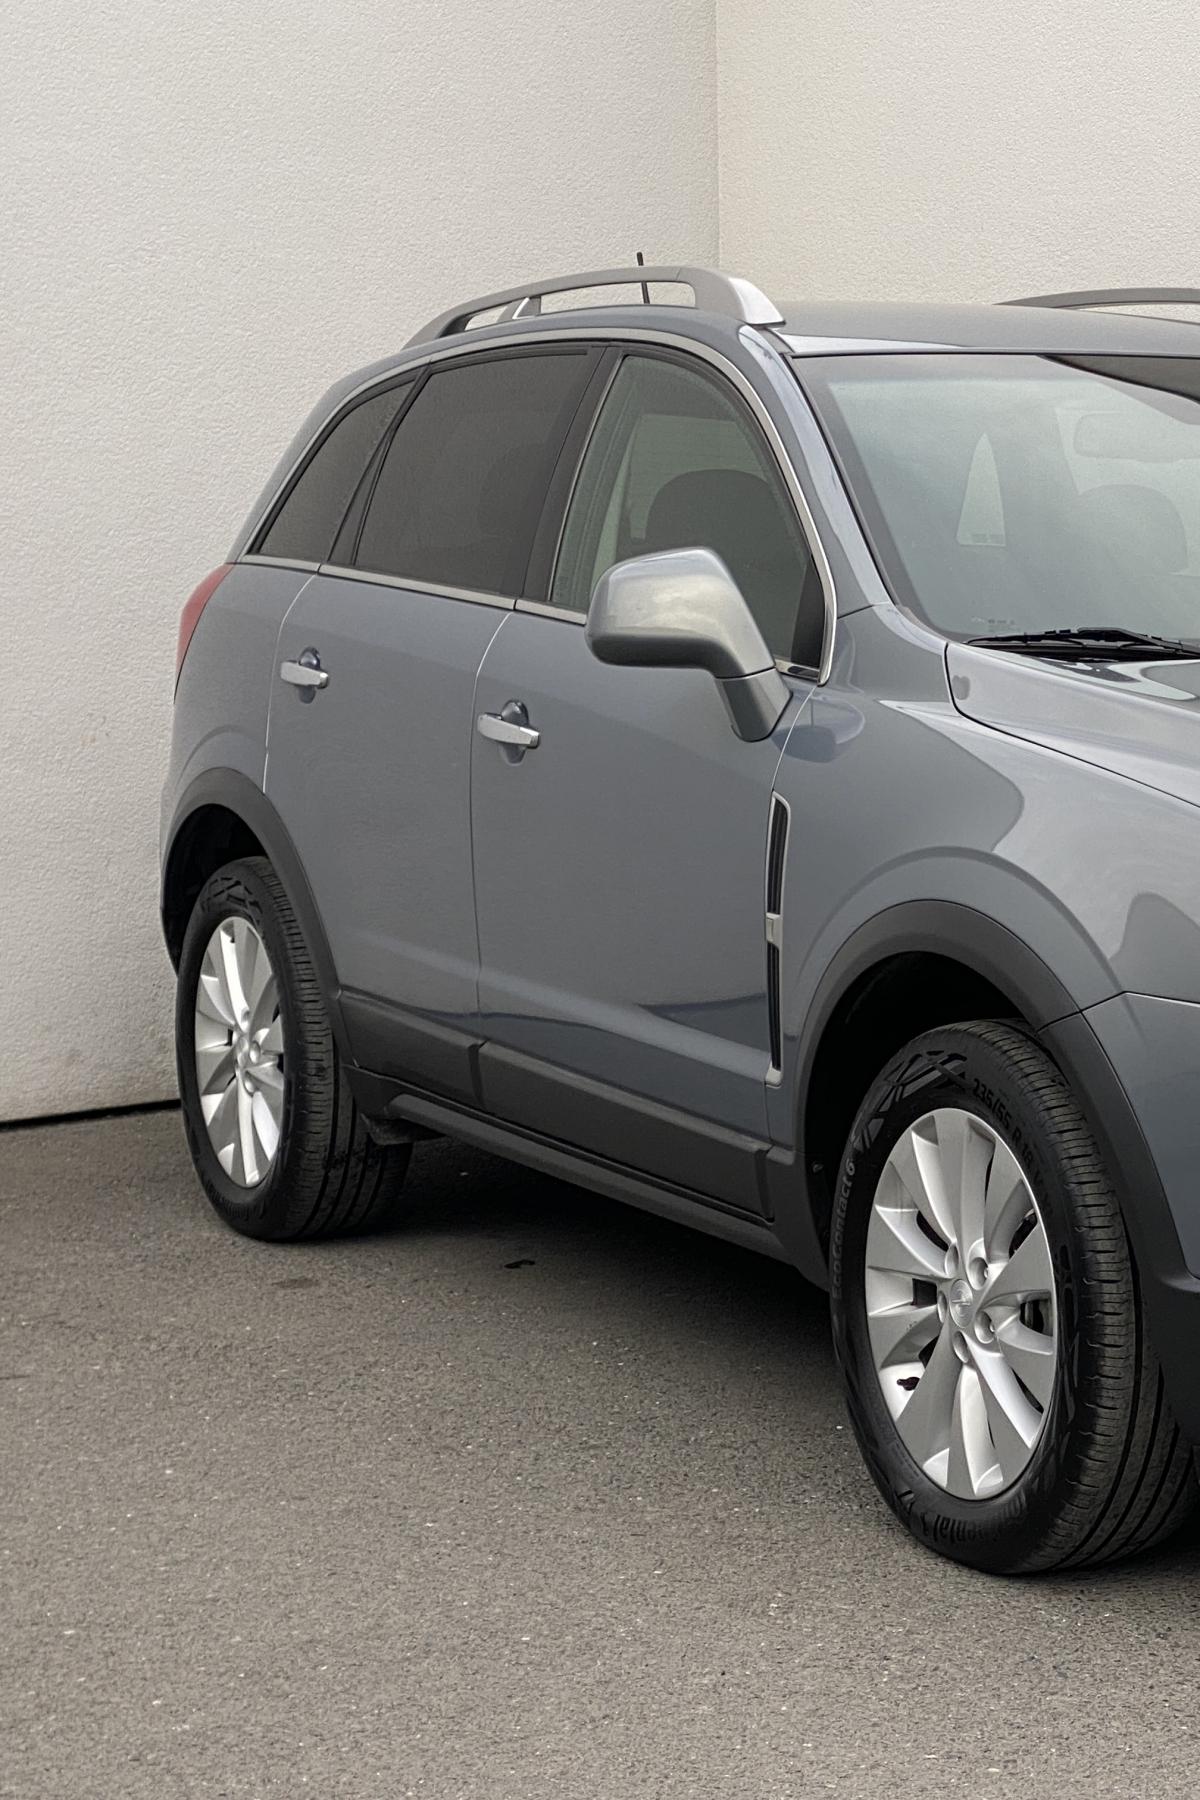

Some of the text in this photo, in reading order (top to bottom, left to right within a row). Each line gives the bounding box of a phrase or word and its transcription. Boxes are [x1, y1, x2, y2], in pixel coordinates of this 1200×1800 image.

[972, 1078, 1012, 1129] 235/55
[832, 1158, 856, 1299] EcoContact 6
